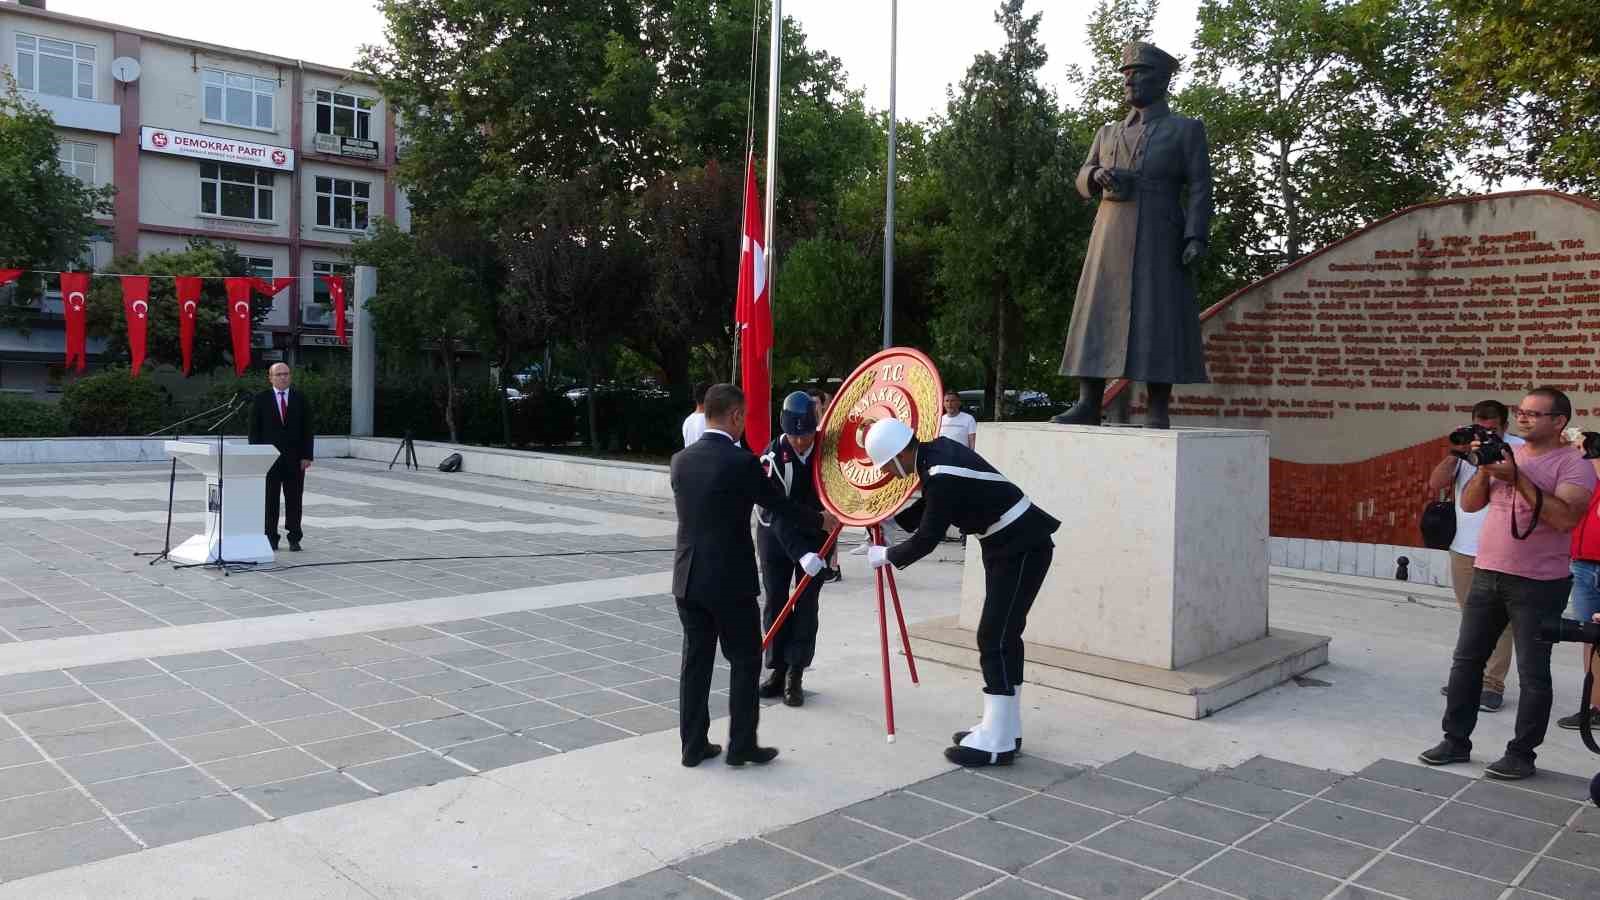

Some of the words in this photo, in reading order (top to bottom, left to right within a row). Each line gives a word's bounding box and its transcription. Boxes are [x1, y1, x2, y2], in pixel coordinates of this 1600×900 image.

[174, 136, 235, 153] DEMOKRAT
[238, 146, 266, 157] PARTİ
[1468, 244, 1499, 257] Türk
[1560, 238, 1585, 250] Türk
[881, 363, 905, 383] T.C.
